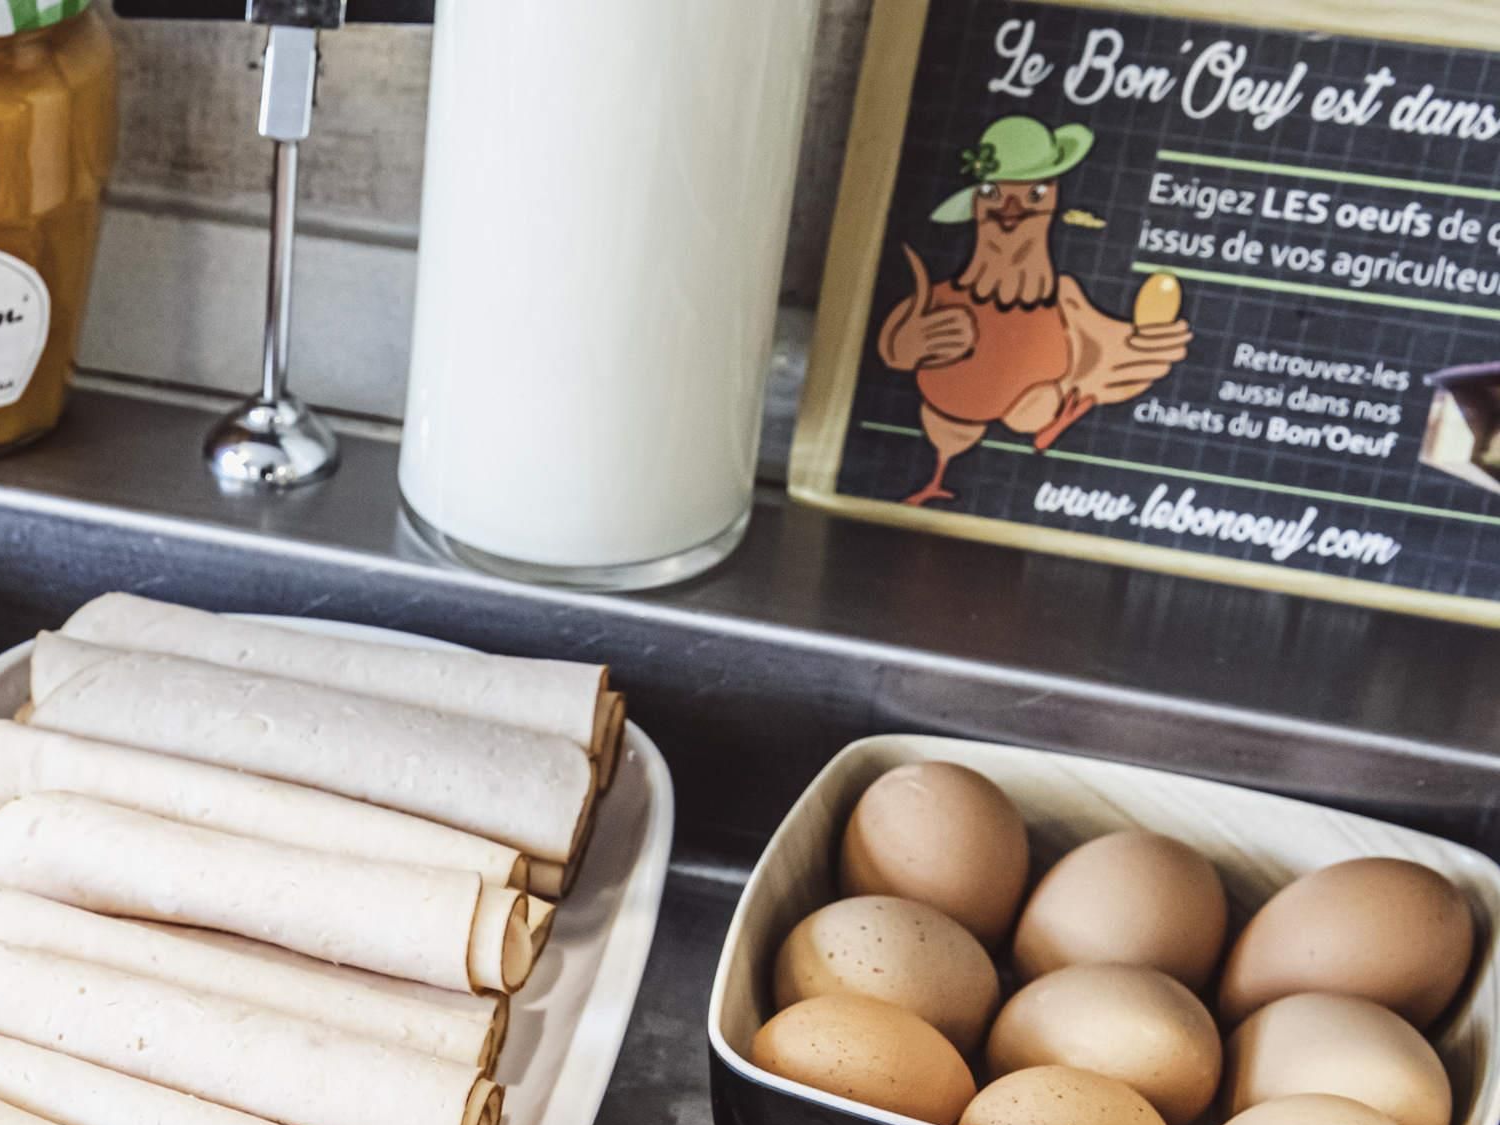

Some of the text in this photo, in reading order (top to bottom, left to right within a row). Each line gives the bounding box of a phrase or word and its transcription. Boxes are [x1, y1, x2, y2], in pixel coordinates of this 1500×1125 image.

[988, 19, 1054, 97] Le
[1311, 66, 1396, 126] est
[1389, 84, 1500, 141] dans
[1149, 172, 1256, 219] Exigez
[1261, 187, 1331, 224] LES
[1335, 201, 1433, 238] oeufs
[1437, 208, 1482, 244] de
[1138, 219, 1216, 259] issus
[1221, 230, 1264, 265] de
[1270, 244, 1326, 274] vos
[1233, 343, 1411, 391] Retrouvez-les
[1133, 397, 1399, 458] chalets du Bon'Oeuf
[1218, 380, 1401, 425] aussi dans nos
[1034, 481, 1402, 565] www.lebonoeuf.com
